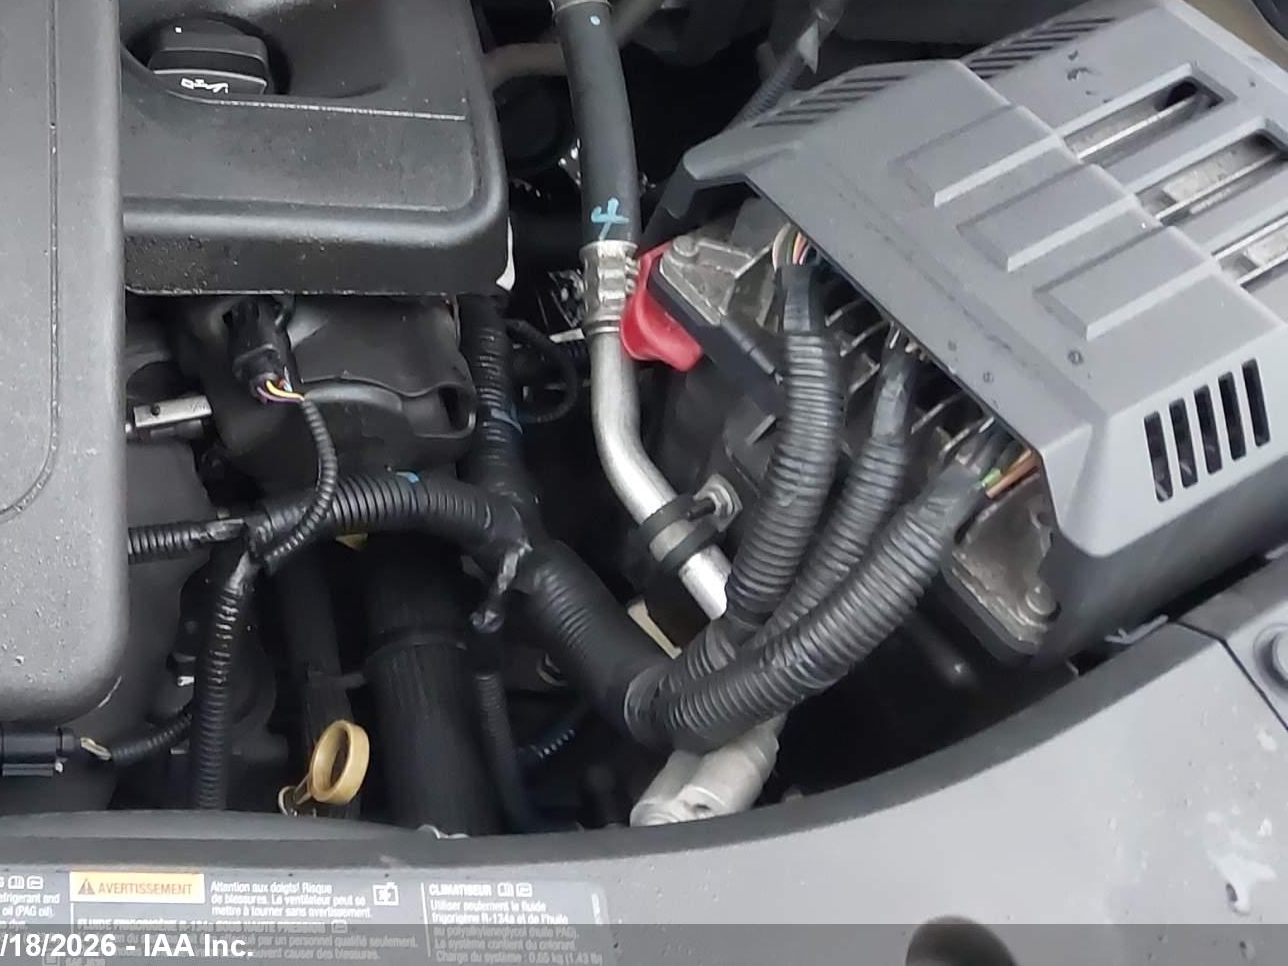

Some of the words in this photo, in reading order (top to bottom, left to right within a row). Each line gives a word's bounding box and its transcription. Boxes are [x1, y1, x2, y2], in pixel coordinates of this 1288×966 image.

[98, 882, 192, 895] AVERTISSEMENT
[211, 881, 250, 893] Attention
[252, 884, 269, 893] aux
[302, 883, 332, 895] Risque
[428, 884, 492, 896] CLIMATISEUR
[43, 893, 60, 904] and
[211, 894, 222, 904] de
[271, 894, 283, 905] Le
[284, 895, 331, 905] ventilateur
[333, 895, 353, 907] peut
[354, 896, 366, 906] se
[2, 906, 13, 916] oil
[211, 906, 241, 916] mettre
[251, 906, 283, 917] tourner
[285, 908, 307, 917] sans
[430, 899, 461, 911] Utiliser
[463, 900, 509, 912] seulement
[521, 900, 546, 912] fluide
[528, 913, 538, 924] de
